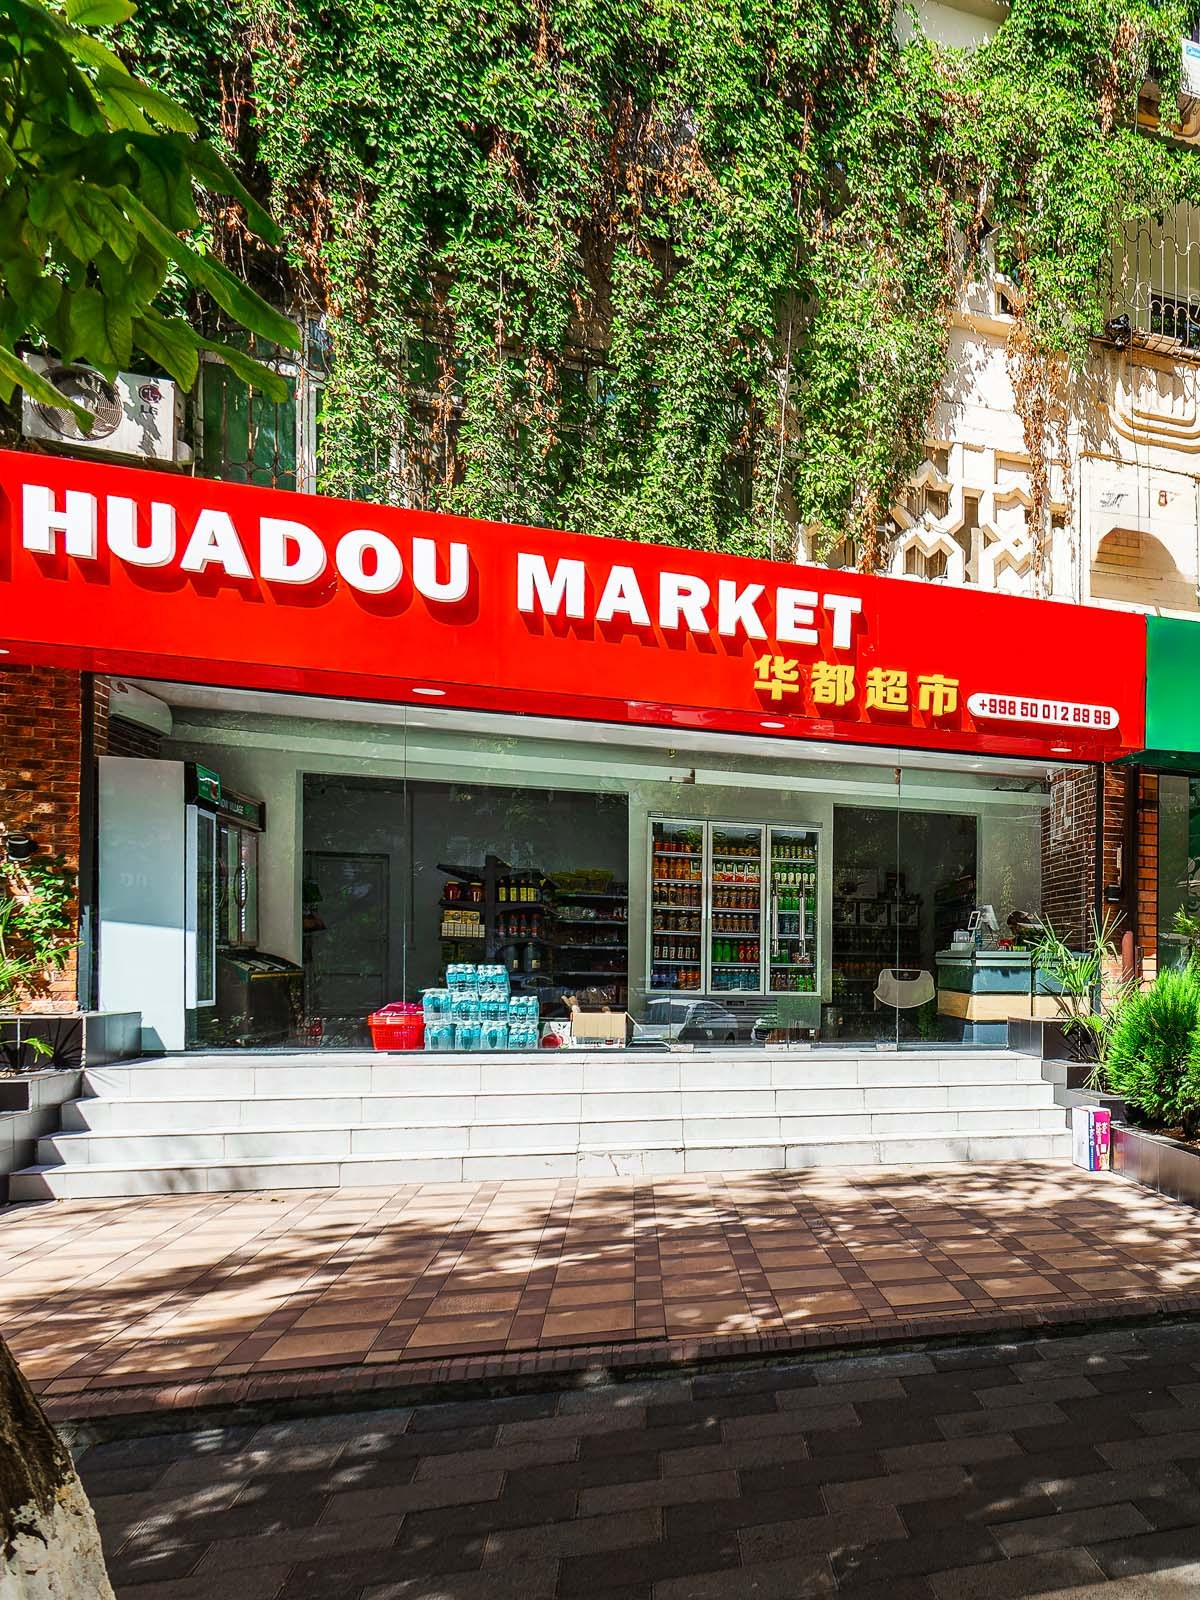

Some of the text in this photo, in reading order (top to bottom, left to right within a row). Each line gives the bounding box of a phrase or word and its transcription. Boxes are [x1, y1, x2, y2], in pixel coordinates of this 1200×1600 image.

[22, 483, 862, 650] HUADOU MARKET
[753, 654, 960, 717] 华都超市
[979, 698, 1111, 726] +998 50 012 89 99
